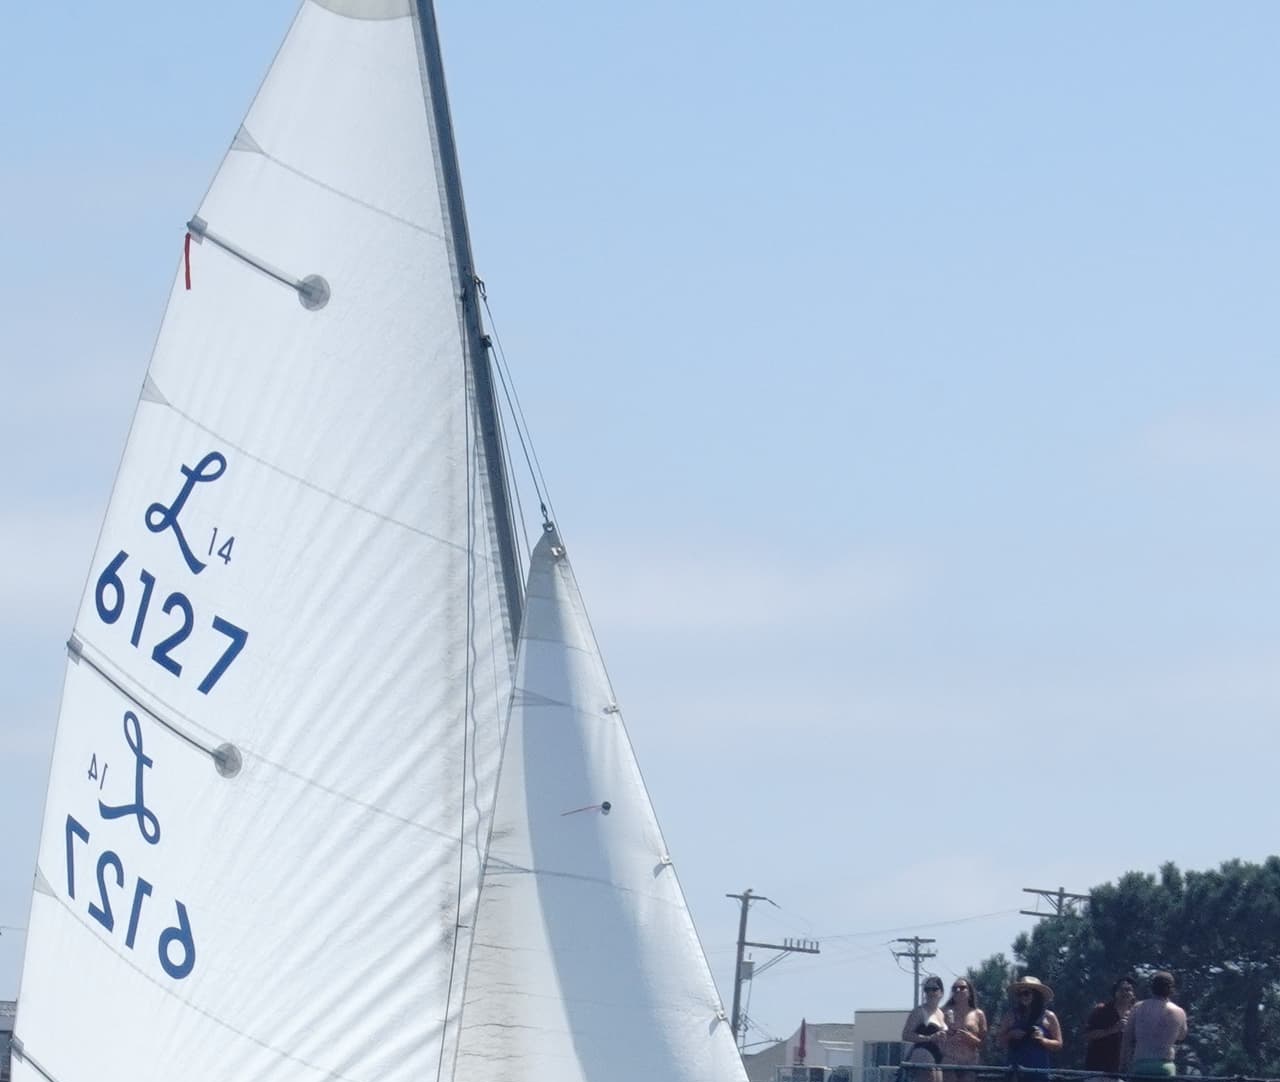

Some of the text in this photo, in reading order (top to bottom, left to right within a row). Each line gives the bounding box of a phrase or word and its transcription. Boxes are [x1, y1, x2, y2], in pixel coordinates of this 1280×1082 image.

[144, 451, 235, 575] L 14
[95, 550, 249, 695] 6127
